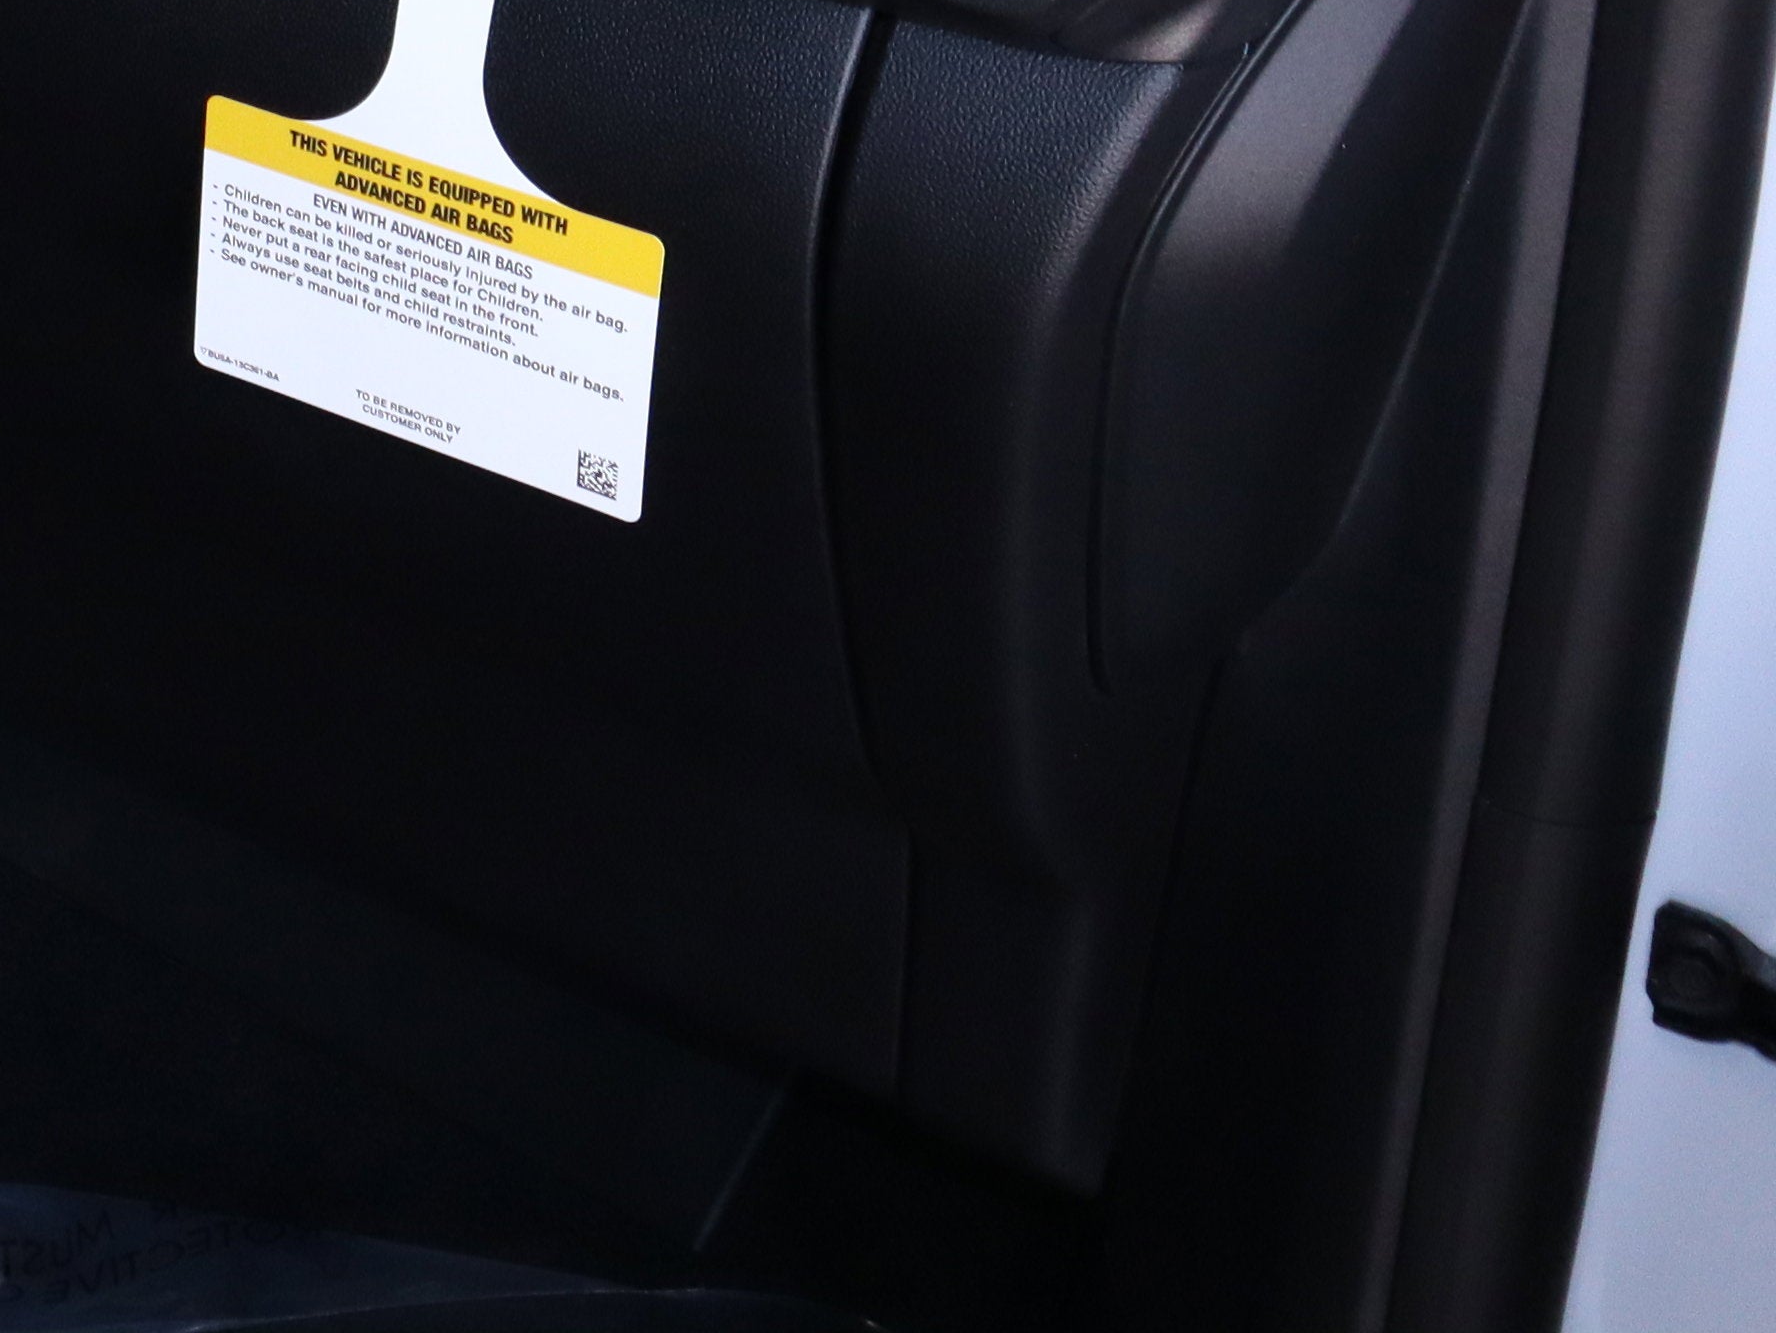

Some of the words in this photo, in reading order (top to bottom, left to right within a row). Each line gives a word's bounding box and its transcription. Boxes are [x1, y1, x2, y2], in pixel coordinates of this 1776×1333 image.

[290, 130, 327, 157] THIS
[332, 144, 401, 182] VEHICLE
[406, 168, 423, 188] IS
[428, 176, 515, 218] EQUIPPED
[521, 205, 568, 235] WITH
[313, 192, 348, 217] EVEN
[351, 205, 387, 231] WITH
[390, 220, 463, 256] ADVANCED
[466, 246, 491, 266] AIR
[495, 254, 533, 280] BAGS
[335, 171, 426, 214] ADVANCED
[431, 203, 461, 226] AIR
[466, 213, 513, 244] BAGS
[221, 232, 271, 259] Always
[274, 252, 300, 269] use
[303, 262, 333, 281] seat
[336, 271, 370, 294] belts
[374, 287, 401, 305] and
[404, 298, 440, 319] child
[443, 312, 516, 347] restraints.
[222, 215, 262, 239] Never
[265, 232, 289, 249] put
[291, 242, 300, 253] a
[304, 245, 332, 263] rear
[335, 254, 379, 283] facing
[382, 273, 417, 294] child
[420, 287, 451, 307] seat
[455, 296, 468, 313] in
[472, 303, 496, 322] the
[499, 312, 538, 337] front.
[223, 198, 249, 219] The
[252, 209, 286, 232] back
[289, 224, 318, 243] seat
[322, 232, 334, 248] is
[337, 239, 360, 257] the
[363, 250, 407, 274] safest
[410, 266, 449, 289] place
[453, 279, 473, 297] for
[477, 288, 543, 322] Children.
[224, 183, 282, 214] Children
[285, 207, 311, 223] can
[314, 213, 332, 231] be
[335, 220, 373, 245] killed
[376, 238, 392, 251] or
[395, 244, 462, 278] seriously
[465, 266, 517, 295] injured
[521, 285, 540, 305] by
[543, 293, 568, 312] the
[571, 305, 591, 319] air
[595, 309, 628, 334] bag.
[221, 247, 247, 267] See
[250, 260, 304, 287] owner's
[307, 280, 358, 307] manual
[362, 297, 382, 315] for
[385, 308, 422, 330] more
[425, 320, 509, 361] information
[512, 354, 555, 378] about
[559, 370, 579, 385] air
[583, 376, 624, 402] bags.
[355, 388, 371, 402] TO
[372, 394, 388, 409] BE
[389, 401, 444, 429] REMOVED
[445, 421, 462, 436] BY
[362, 403, 422, 434] CUSTOMER
[424, 426, 454, 444] ONLY
